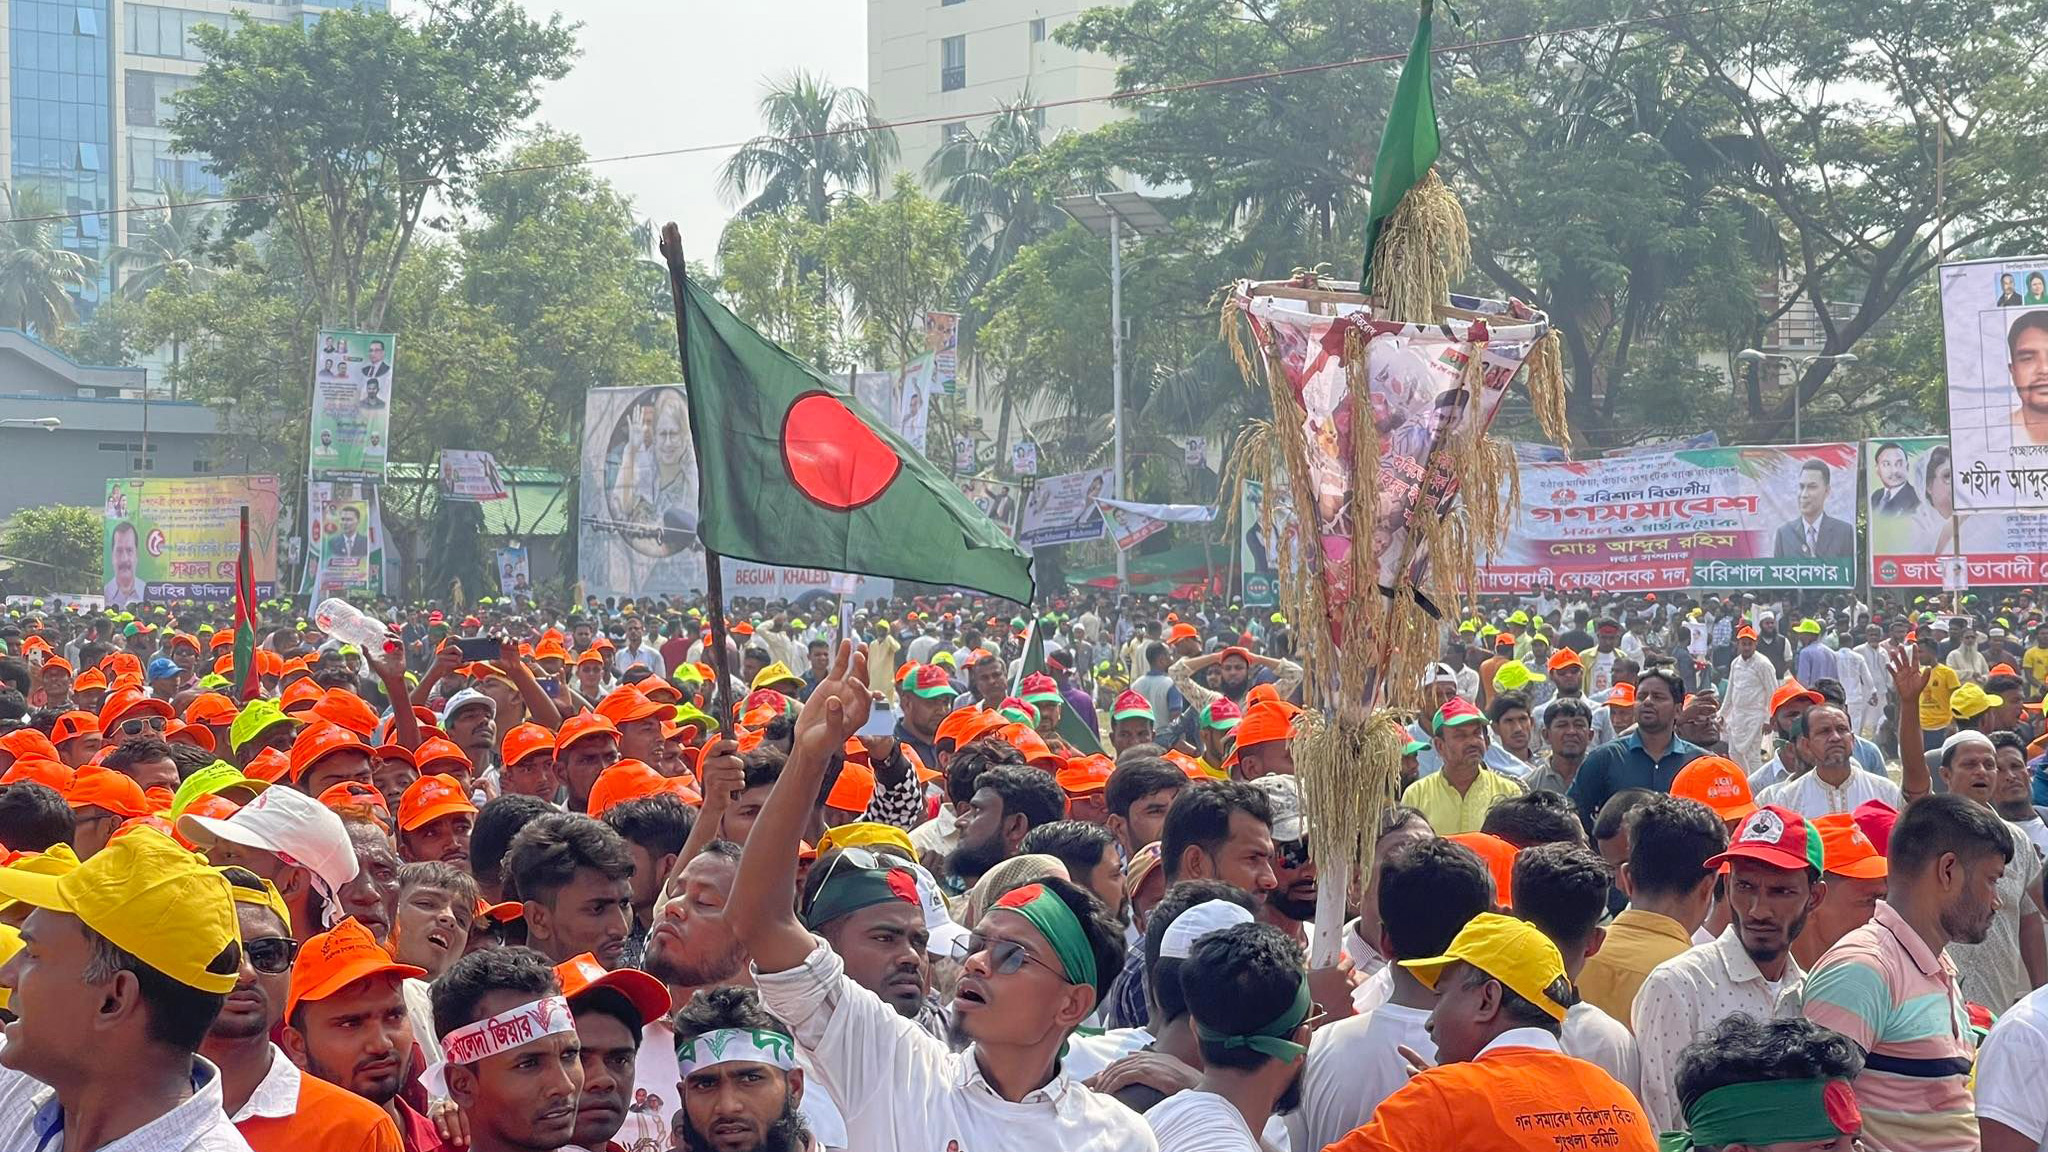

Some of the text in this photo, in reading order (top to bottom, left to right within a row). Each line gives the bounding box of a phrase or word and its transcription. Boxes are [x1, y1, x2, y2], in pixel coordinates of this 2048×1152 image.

[1377, 469, 1409, 497] হিদুল
[1959, 460, 2001, 499] শহীদ
[1584, 481, 1710, 503] বরিশাল বিভাগীয়
[1530, 494, 1760, 525] গণসমাবেশ
[1549, 532, 1737, 556] মোঃ আব্দুর রহিম
[170, 561, 210, 579] সফল
[736, 569, 775, 585] BEGUM
[783, 569, 829, 584] KHALED
[1560, 569, 1656, 588] স্বেচ্ছাসেবক
[1694, 560, 1765, 582] বরিশাল
[1769, 564, 1838, 583] মহানগর
[148, 584, 186, 597] জহির
[191, 584, 230, 597] উদ্দিন
[487, 1015, 533, 1050] জিয়ার
[1515, 1114, 1532, 1131] গন
[1534, 1111, 1574, 1128] সমাবেশ
[1574, 1106, 1613, 1126] বরিশাল
[1588, 1127, 1620, 1147] কমিটি
